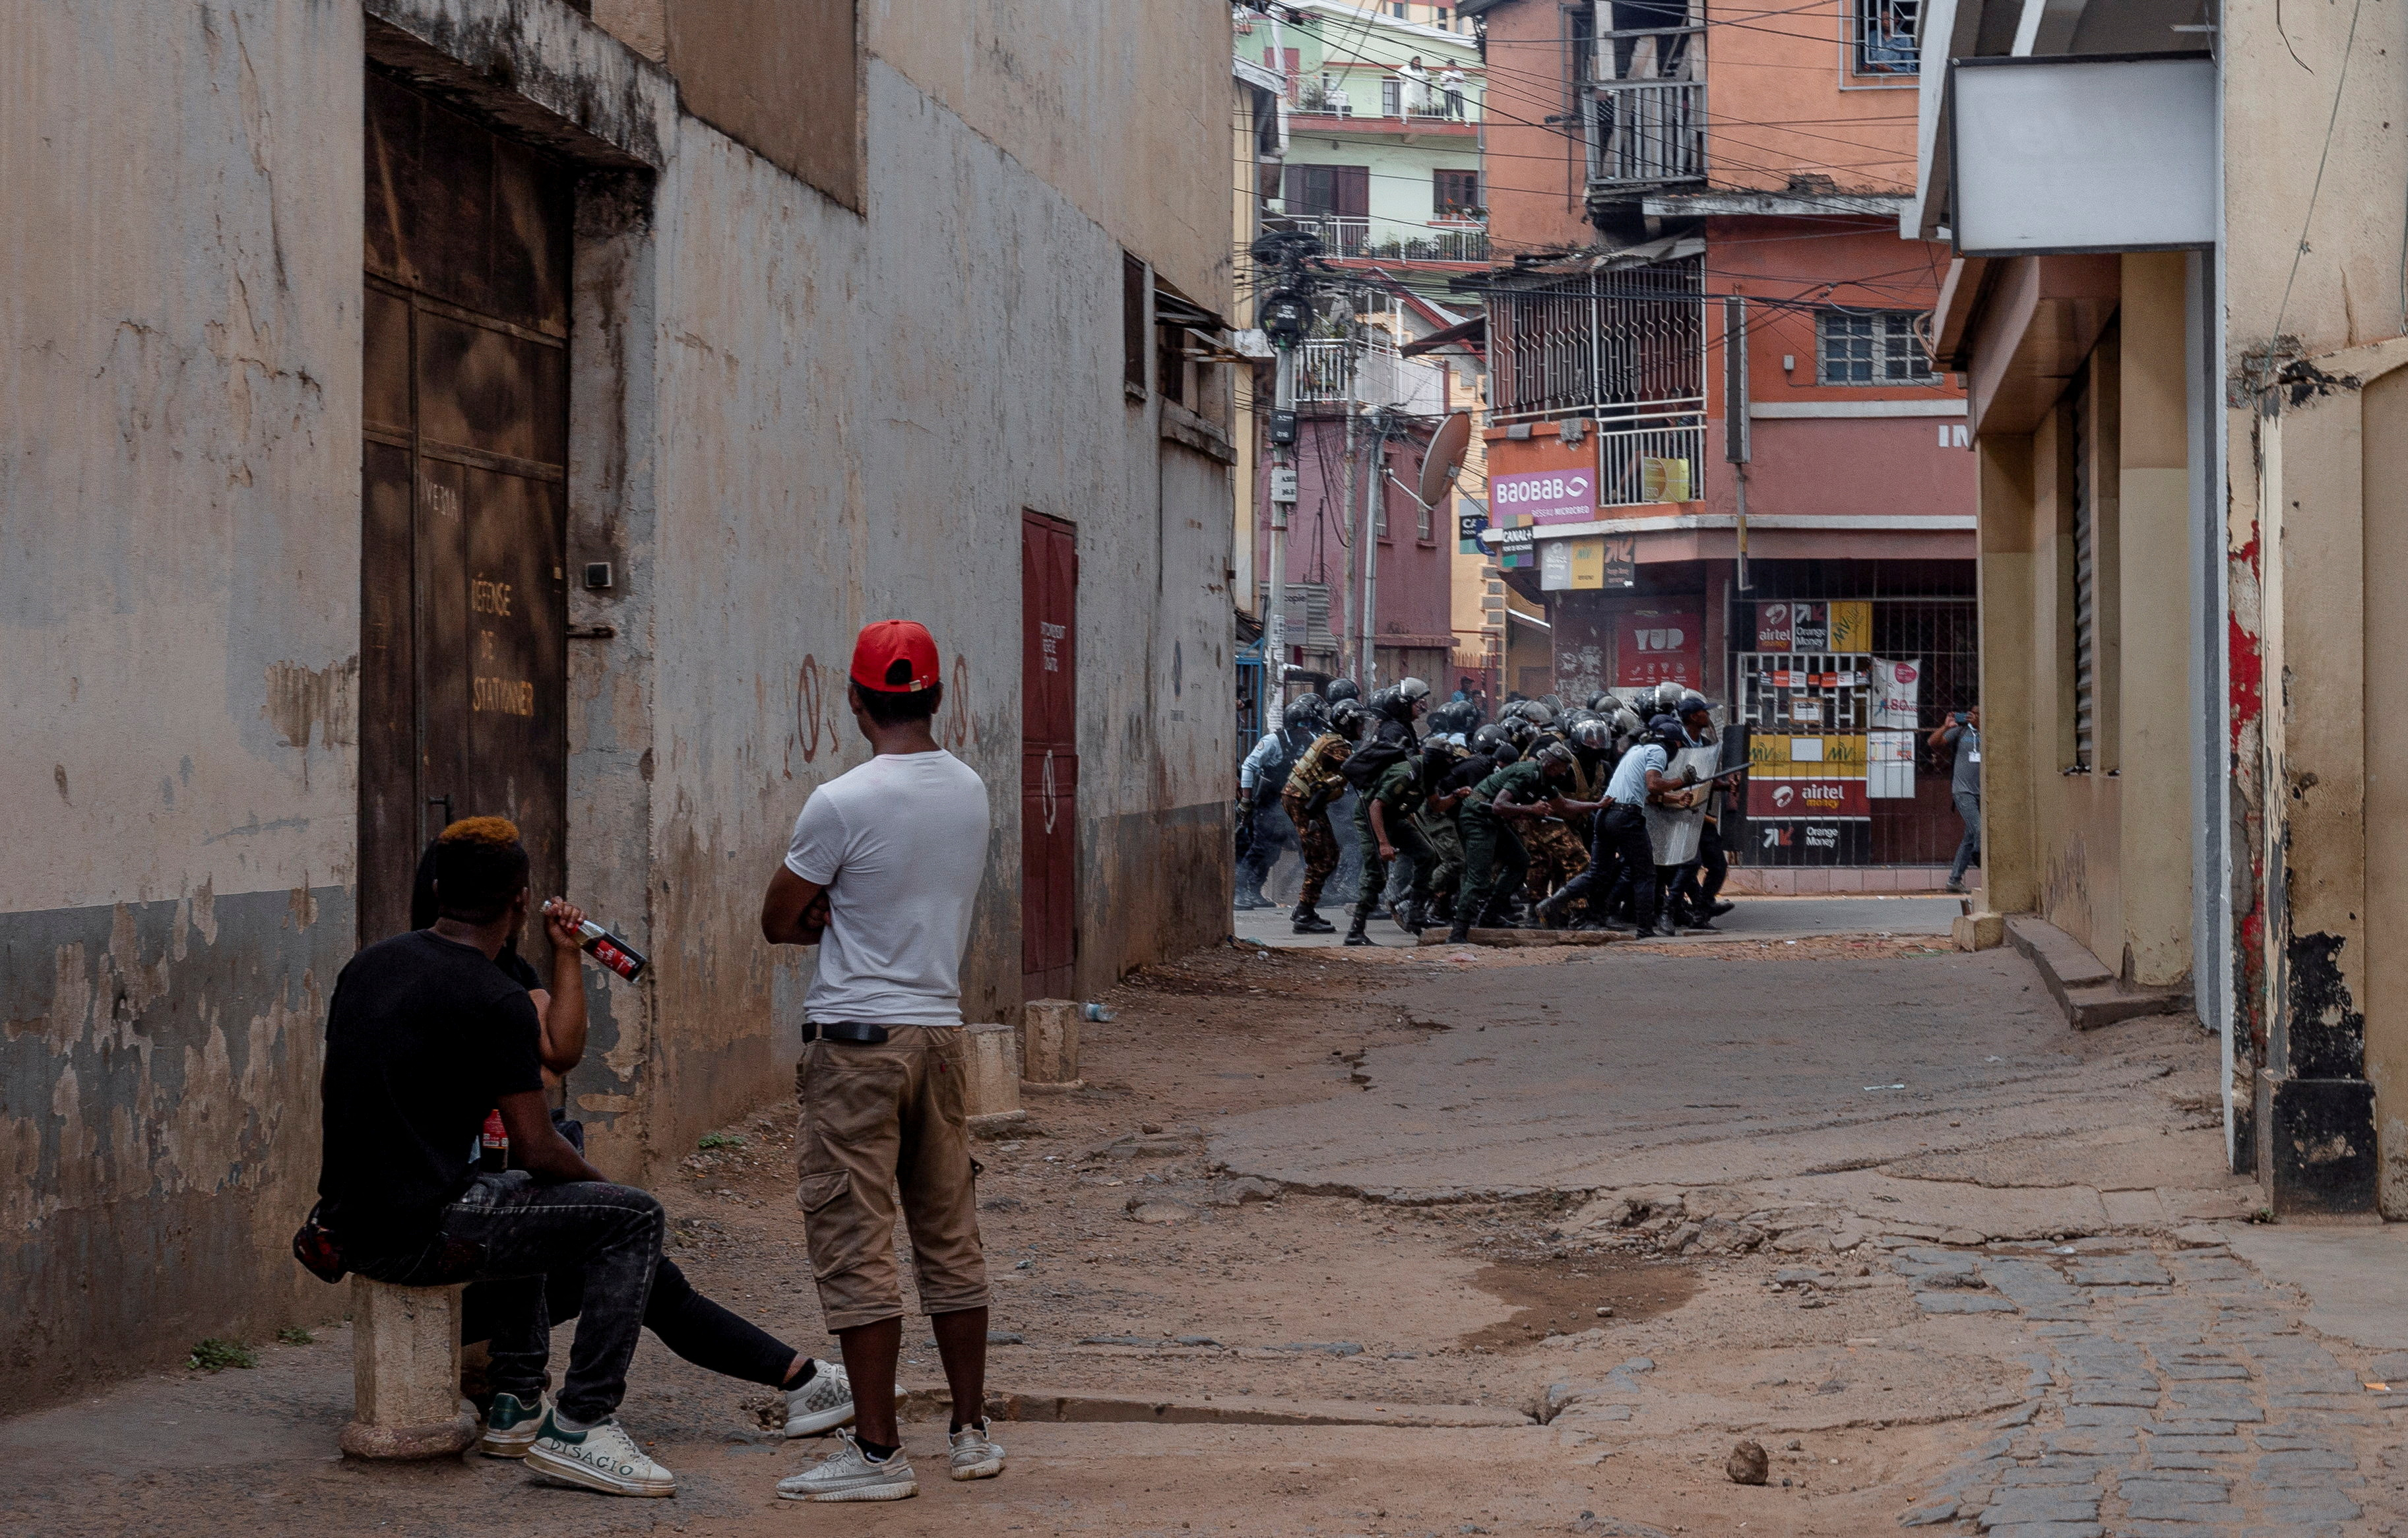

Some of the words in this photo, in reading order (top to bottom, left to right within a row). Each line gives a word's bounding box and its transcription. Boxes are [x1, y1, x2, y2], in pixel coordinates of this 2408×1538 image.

[1503, 530, 1533, 543] CANAL+
[1759, 629, 1792, 641] airtel
[1796, 627, 1826, 637] Orange
[1634, 628, 1684, 651] YUP
[1796, 636, 1825, 647] Money
[1802, 784, 1845, 799] airtel
[1806, 799, 1840, 809] money
[1806, 826, 1839, 838] Orange
[1806, 836, 1835, 848] Money
